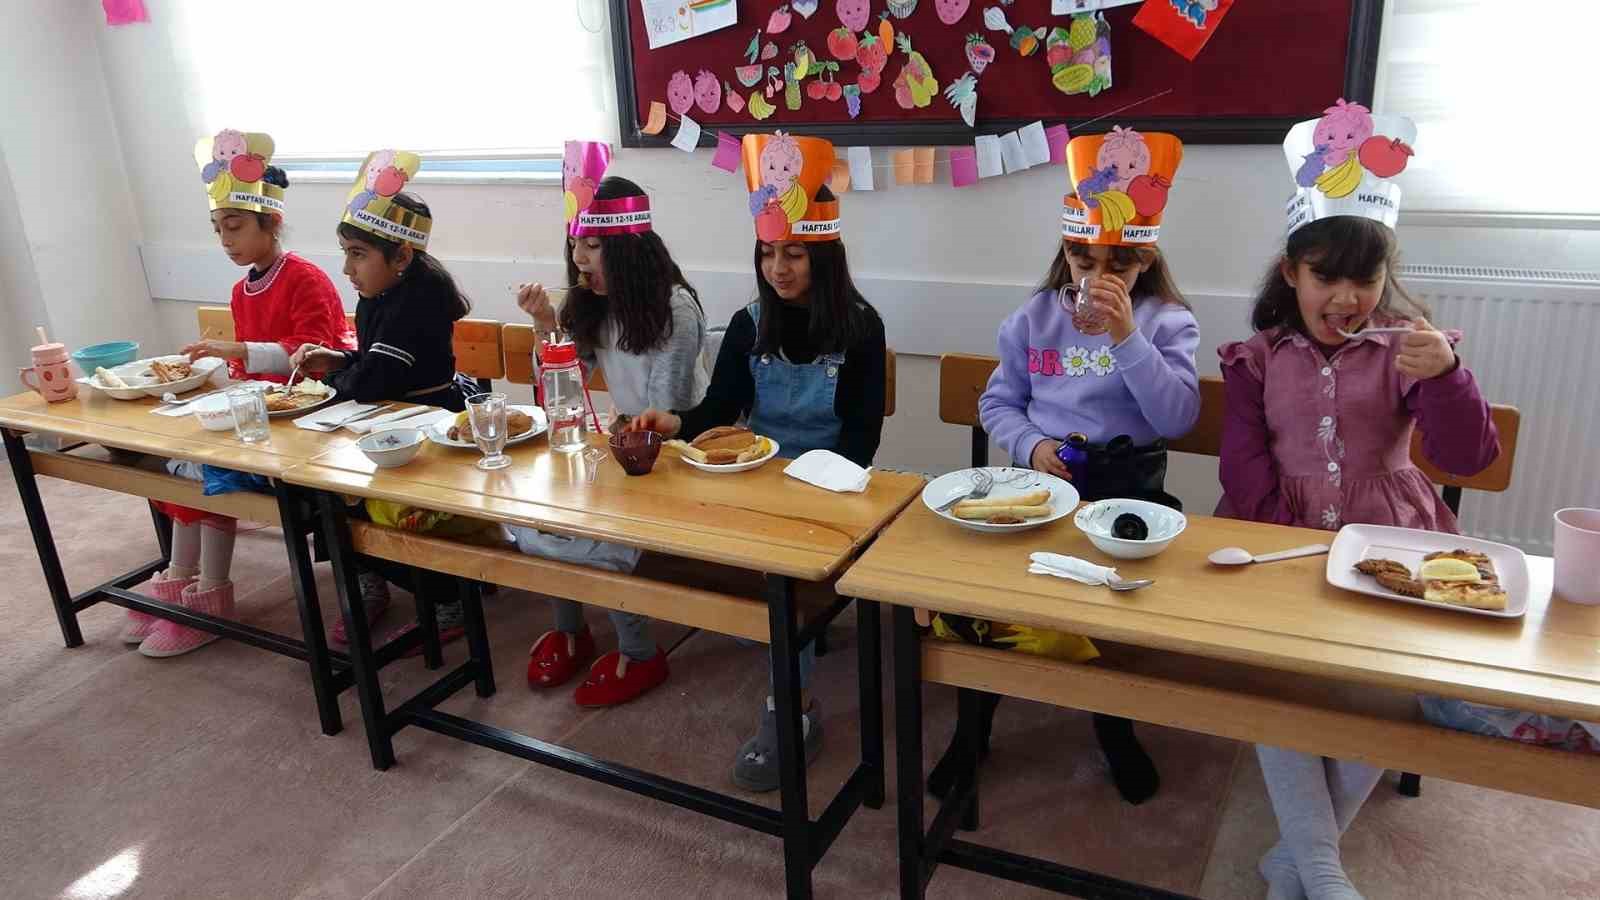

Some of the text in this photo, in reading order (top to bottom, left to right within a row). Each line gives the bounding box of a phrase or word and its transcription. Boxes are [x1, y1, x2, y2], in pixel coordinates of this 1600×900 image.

[235, 193, 266, 204] HAFTASI
[357, 212, 387, 228] HAFTASI
[580, 216, 613, 225] HAFTASI
[802, 223, 833, 232] HAFTASI
